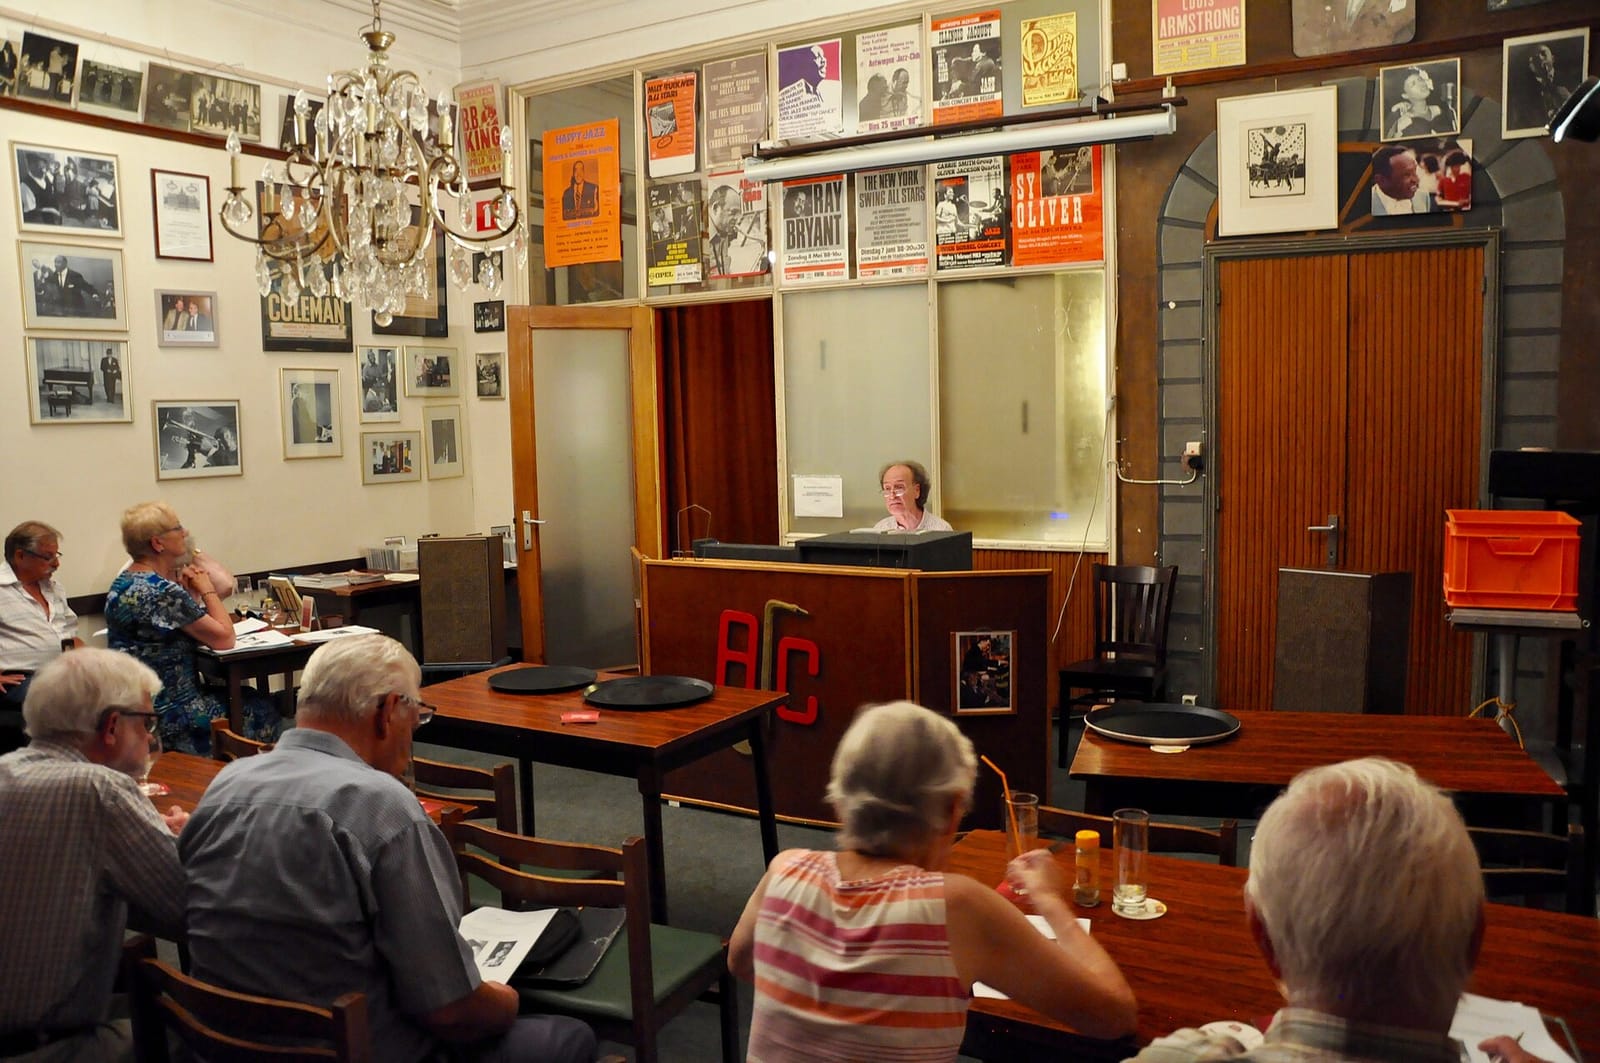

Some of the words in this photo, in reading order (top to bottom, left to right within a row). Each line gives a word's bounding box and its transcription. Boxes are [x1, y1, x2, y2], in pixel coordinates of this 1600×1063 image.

[938, 28, 964, 44] ILLINOIS
[1160, 6, 1240, 38] ARMSTRONG
[464, 126, 500, 152] KING
[864, 174, 878, 190] THE
[879, 172, 896, 188] NEW
[898, 170, 918, 187] YORK
[1016, 172, 1035, 200] SY
[814, 181, 842, 214] RAY
[859, 190, 886, 208] SWING
[888, 188, 900, 205] ALL
[902, 186, 926, 204] STARS
[1016, 196, 1083, 229] OLIVER
[786, 214, 842, 250] BRYANT
[656, 271, 674, 279] OPEL
[268, 292, 345, 324] COLEMAN
